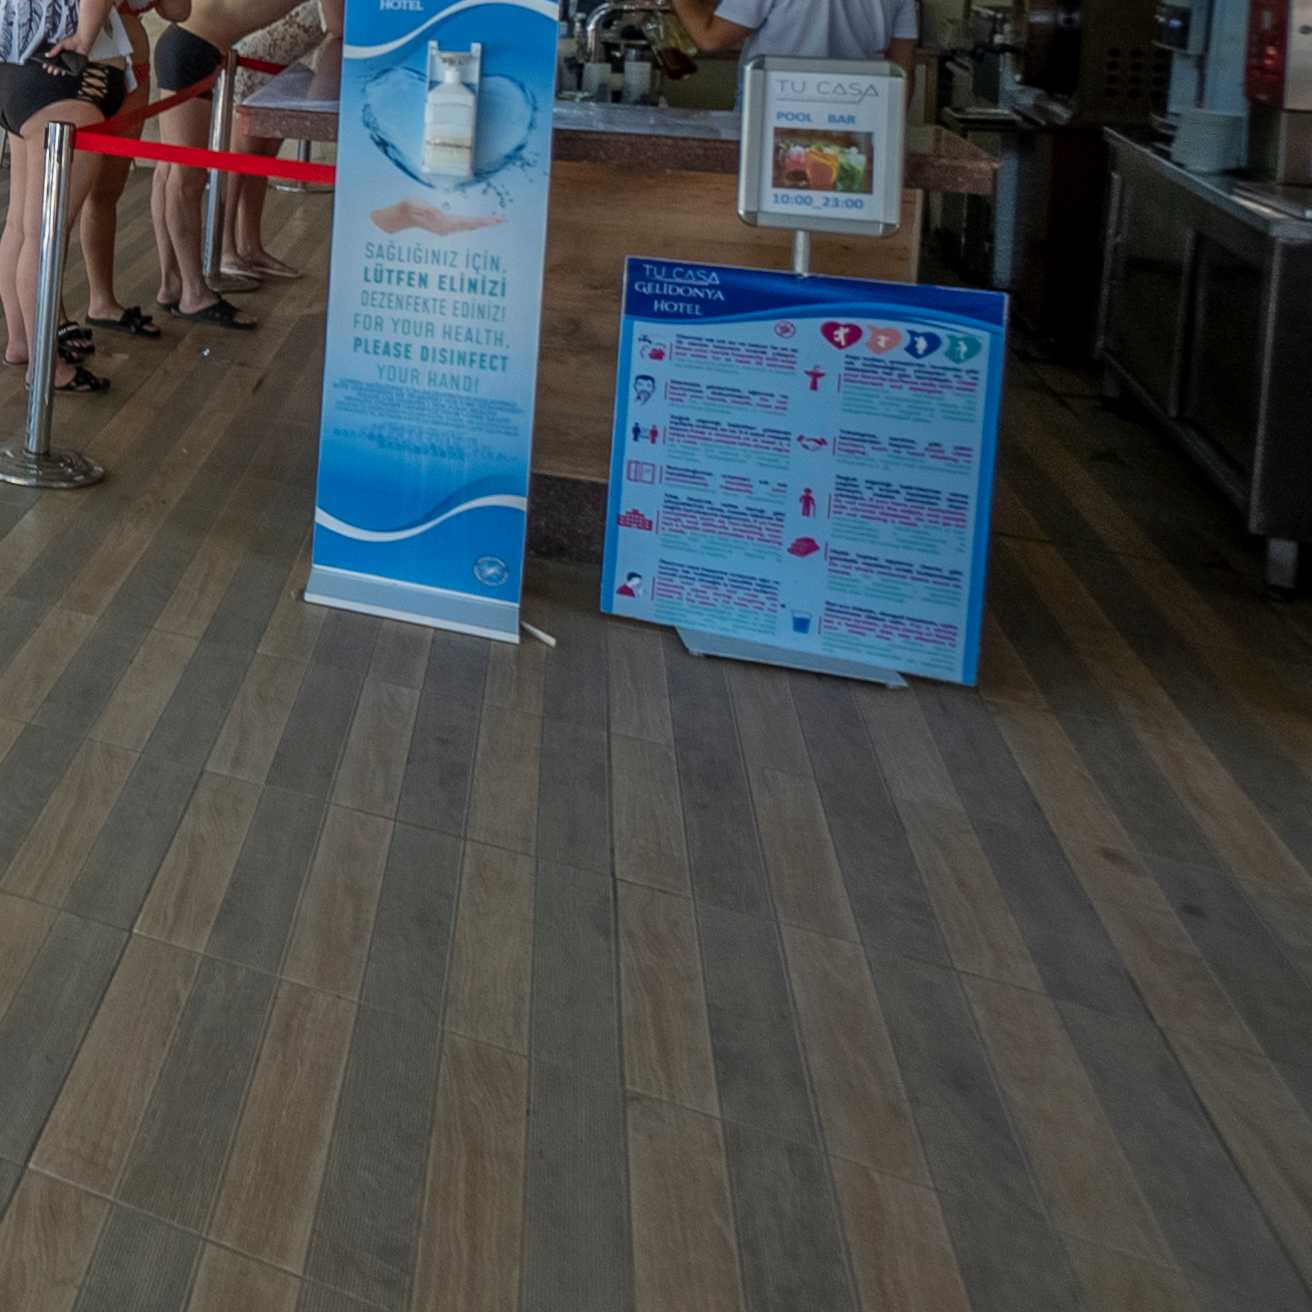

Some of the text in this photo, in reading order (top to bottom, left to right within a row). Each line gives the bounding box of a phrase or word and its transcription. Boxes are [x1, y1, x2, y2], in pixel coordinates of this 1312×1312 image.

[775, 79, 880, 101] TU CASA
[776, 111, 857, 125] POOL BAR
[364, 240, 458, 268] SAĞLIĞINIZ
[363, 263, 507, 297] LÜTFEN ELİNİZİ
[643, 264, 720, 285] TU CASA
[361, 290, 447, 316] DEZENFEKTE
[653, 299, 705, 316] HOTEL
[353, 314, 384, 332] FOR
[392, 317, 435, 338] YOUR
[353, 337, 509, 372] PLEASE DISINFECT
[377, 365, 480, 393] YOUR HAND!
